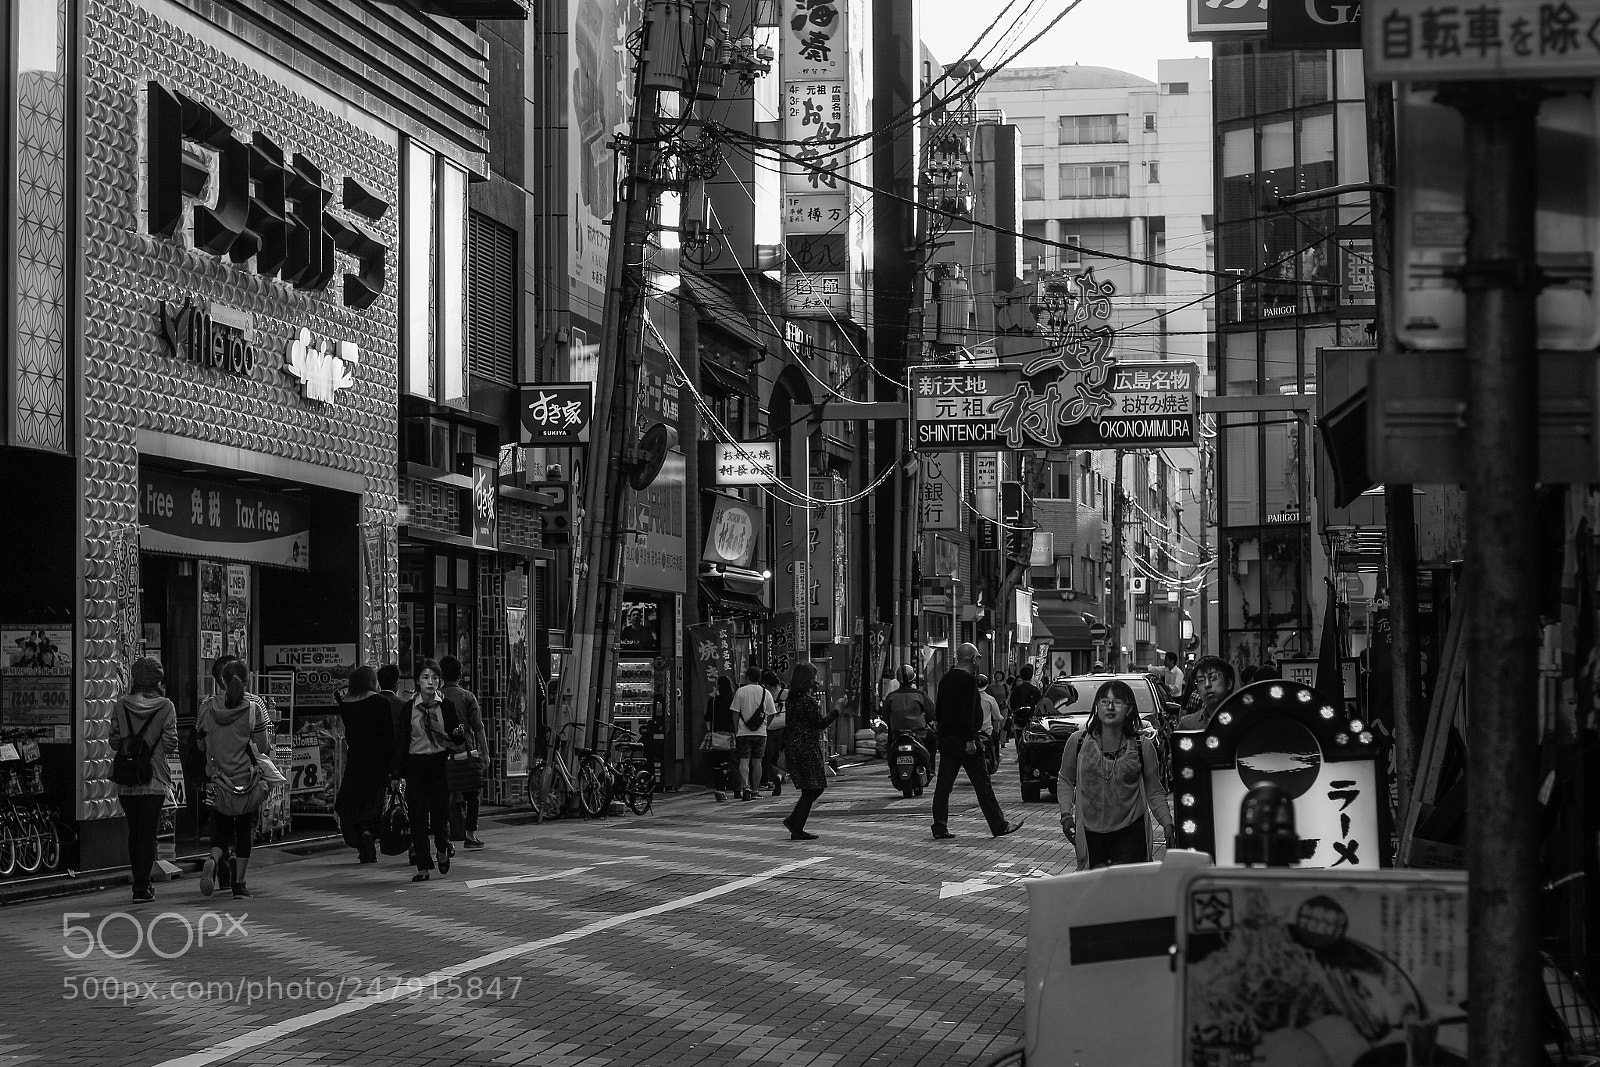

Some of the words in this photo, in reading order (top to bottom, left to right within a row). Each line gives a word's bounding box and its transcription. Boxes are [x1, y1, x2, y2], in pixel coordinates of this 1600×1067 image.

[789, 85, 800, 94] 4F
[806, 85, 826, 95] 元祖
[789, 96, 800, 106] 3F
[831, 85, 841, 120] 広島名物
[789, 107, 800, 117] 2F
[789, 198, 799, 206] 1F
[1263, 304, 1297, 317] PARIGOT
[918, 375, 989, 396] 新天地
[1112, 370, 1191, 390] 広島名物
[528, 390, 582, 430] すき家
[935, 398, 986, 418] 元祖
[1121, 394, 1189, 413] お好み焼き
[1099, 420, 1190, 438] OKONOMIMURA
[723, 449, 772, 461] お好み焼
[146, 483, 174, 518] Free
[475, 467, 495, 525] すき家
[190, 487, 221, 527] 免税
[235, 498, 256, 529] Tax
[257, 501, 281, 533] Free
[276, 653, 324, 664] LINE@
[296, 672, 331, 685] 500
[291, 764, 318, 788] 78
[1327, 780, 1360, 868] ラーメ
